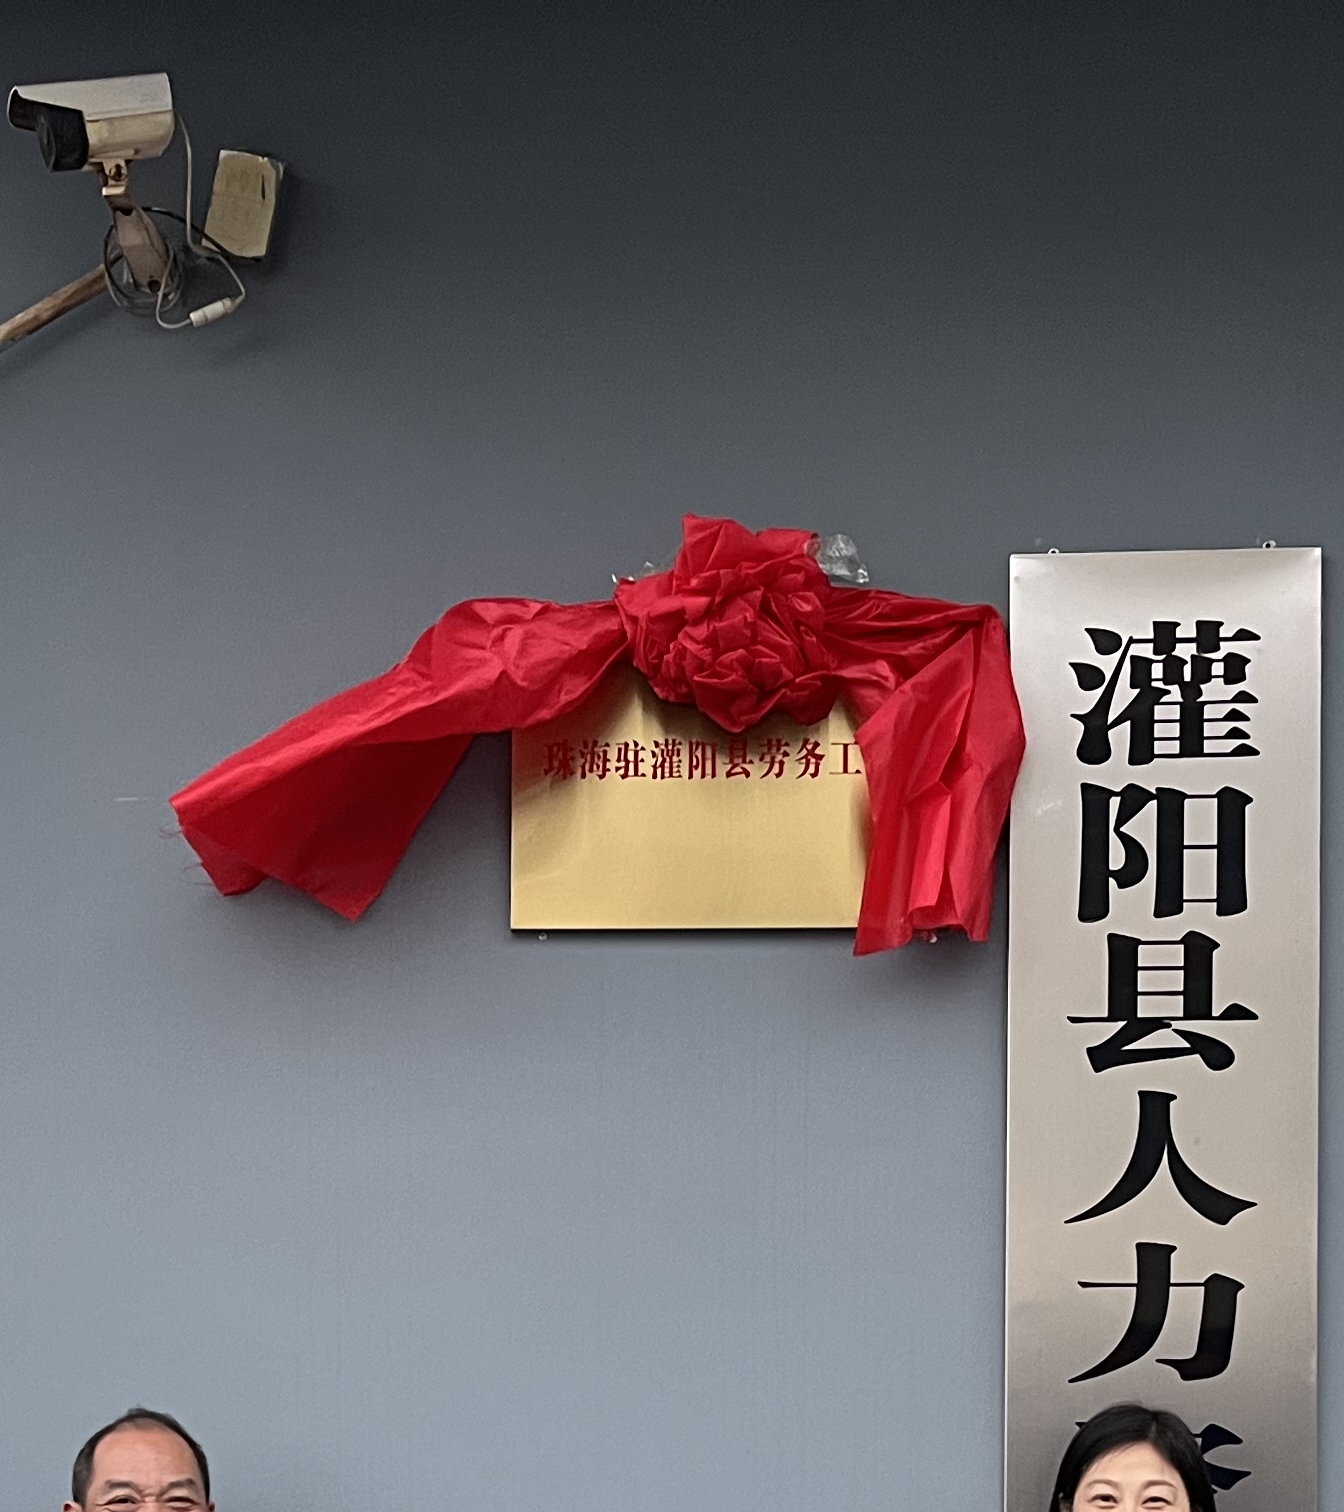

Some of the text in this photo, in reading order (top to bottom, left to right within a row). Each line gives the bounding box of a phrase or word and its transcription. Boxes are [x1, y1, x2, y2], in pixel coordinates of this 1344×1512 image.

[543, 738, 863, 781] 珠海驻灌阳县劳务工
